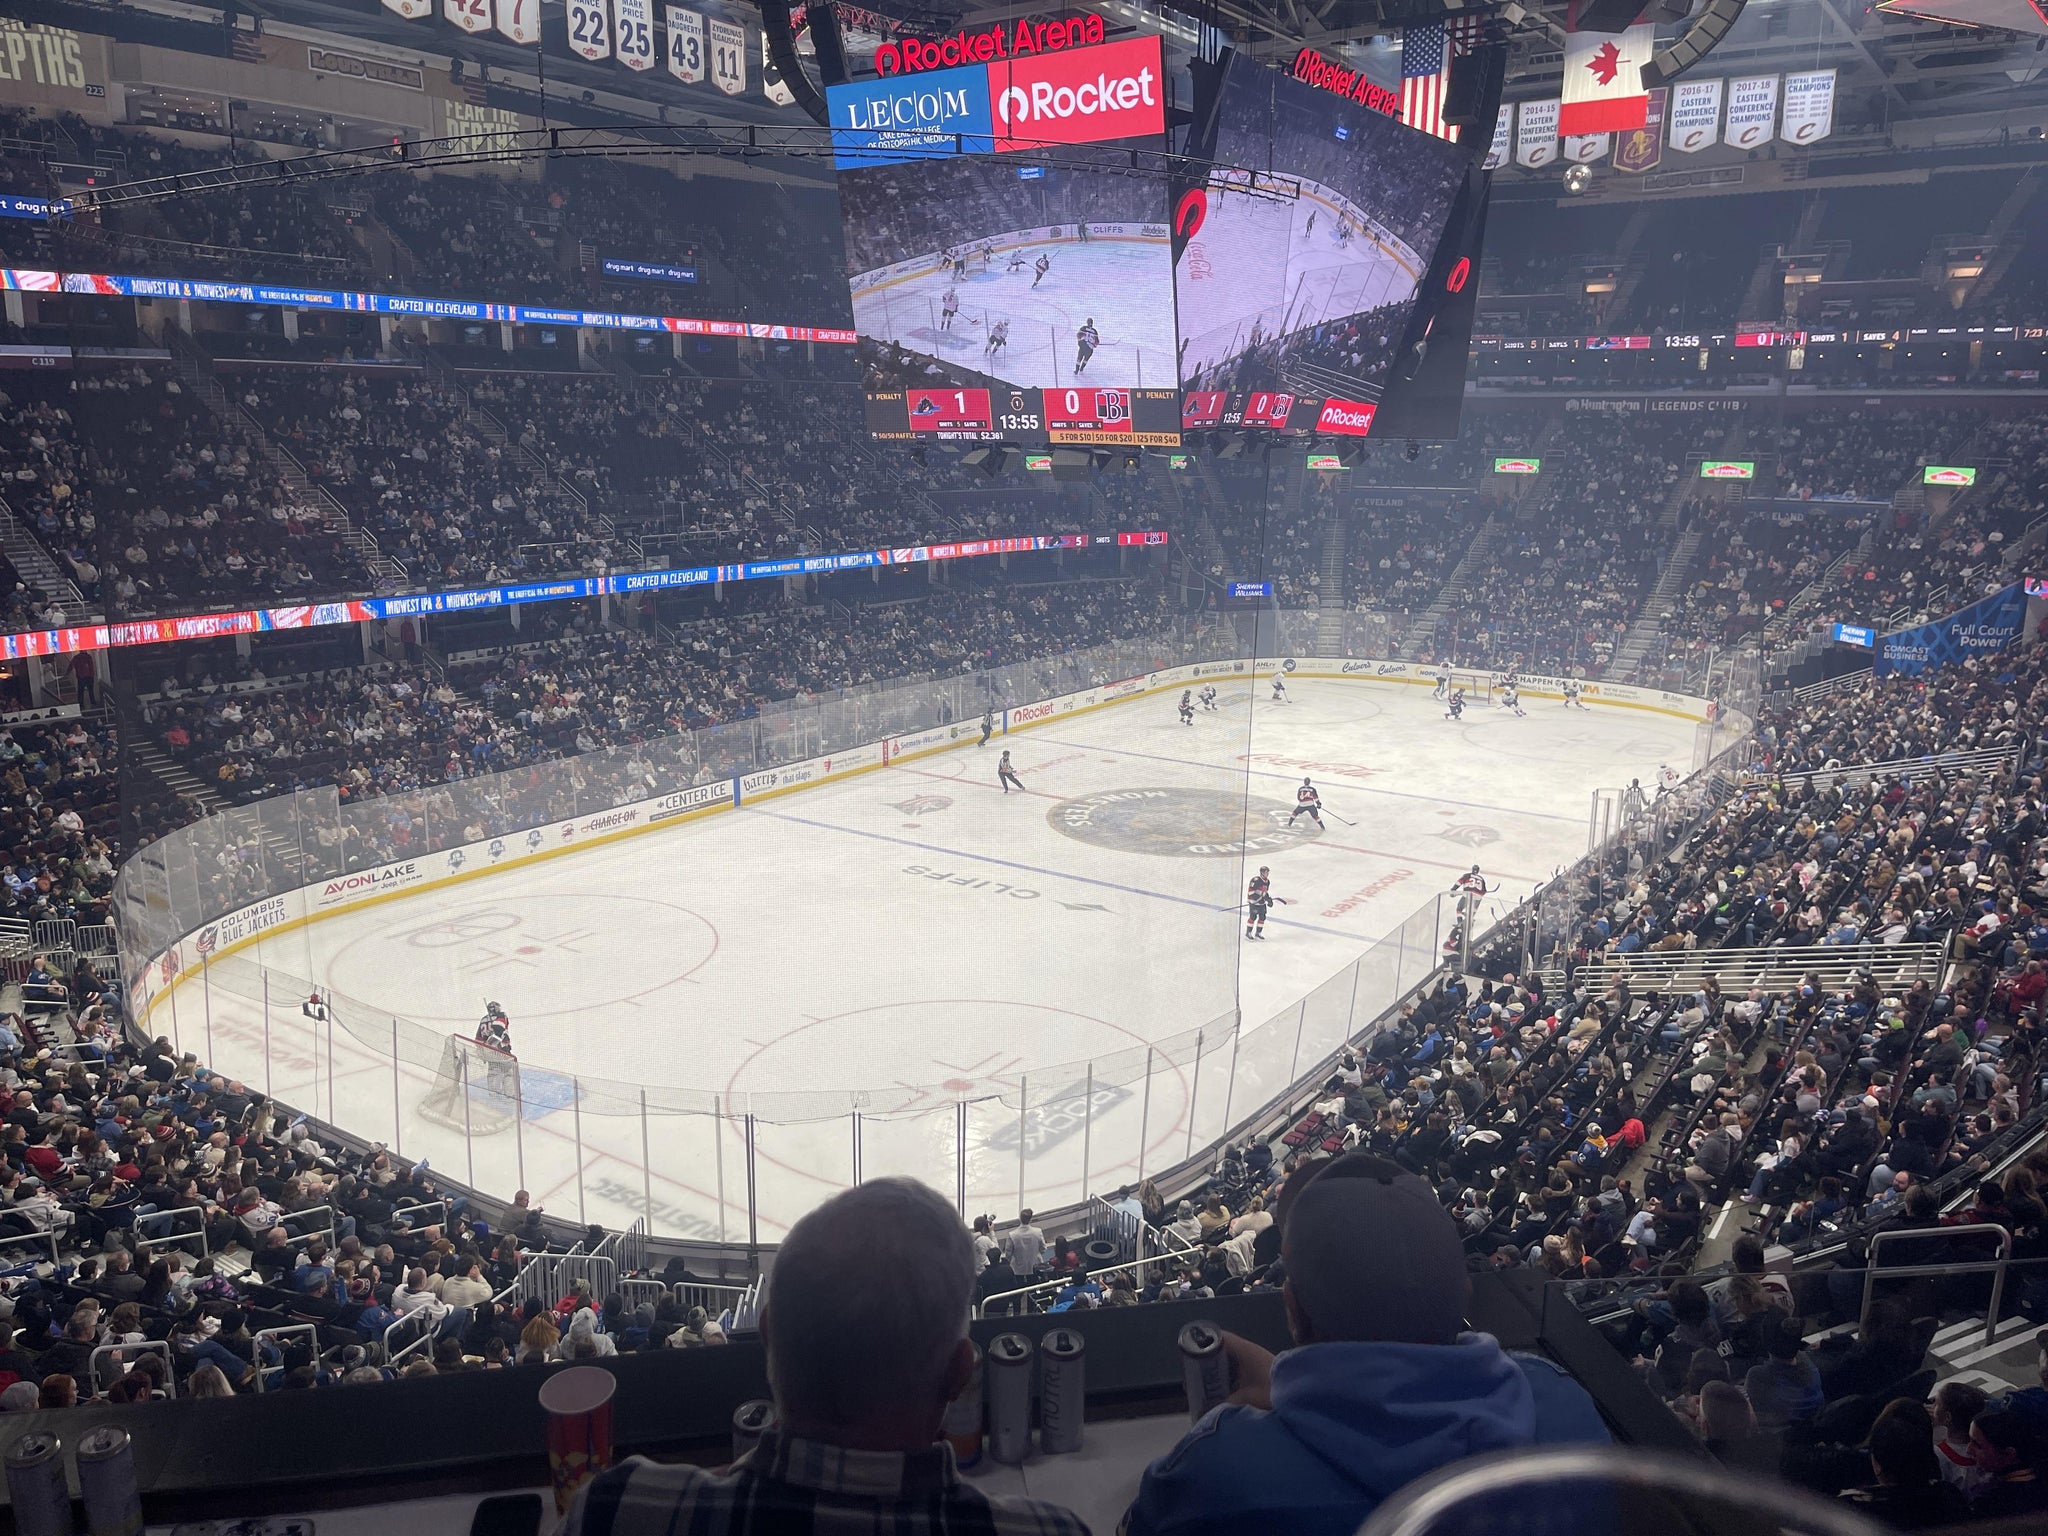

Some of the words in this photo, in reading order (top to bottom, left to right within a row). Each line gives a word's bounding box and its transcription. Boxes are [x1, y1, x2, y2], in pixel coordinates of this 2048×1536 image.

[622, 7, 644, 20] PRICE
[675, 12, 694, 24] BRAD
[572, 6, 605, 47] 22
[712, 23, 743, 39] ZYDRUNAS
[619, 18, 649, 58] 25
[902, 23, 1006, 72] Rocket
[1012, 14, 1104, 55] Arena
[671, 33, 700, 70] 43
[717, 46, 739, 82] 11
[1307, 52, 1356, 100] Rocket
[1353, 75, 1398, 116] Arena
[1736, 80, 1771, 91] 2017-18
[1788, 82, 1831, 93] CHAMPIONS
[86, 85, 105, 97] 223
[1031, 66, 1155, 121] Rocket
[1681, 85, 1714, 96] 2016-17
[1681, 98, 1712, 107] EASTERN
[1737, 93, 1768, 103] EASTERN
[1525, 104, 1556, 115] 2014-15
[1674, 107, 1717, 118] CONFERENCE
[1729, 103, 1774, 113] CONFERENCE
[1525, 116, 1553, 126] EASTERN
[1675, 118, 1714, 128] CHAMPIONS
[1730, 113, 1771, 124] CHAMPIONS
[1520, 124, 1558, 135] CONFERENCE
[1520, 135, 1556, 145] CHAMPIONS
[15, 201, 40, 215] drug
[1093, 225, 1124, 234] CLIFFS
[606, 261, 619, 272] drug
[620, 264, 634, 272] mart
[637, 265, 651, 275] drug
[651, 267, 664, 275] mart
[668, 268, 681, 278] drug
[131, 279, 167, 296] MIDWEST
[168, 281, 181, 296] IPA
[389, 299, 423, 312] CRAFTED
[426, 301, 433, 313] IN
[435, 302, 477, 316] CLEVELAND
[817, 330, 838, 340] CRAFTED
[839, 331, 846, 341] IN
[1665, 335, 1700, 348] 13:55
[1757, 333, 1766, 345] 0
[1810, 334, 1835, 343] SHOTS
[1842, 332, 1847, 342] 1
[1863, 332, 1886, 341] SAVES
[1530, 339, 1537, 349] 5
[1574, 339, 1579, 348] 1
[1623, 337, 1631, 349] 1
[1146, 391, 1174, 399] PENALTY
[954, 391, 966, 414] 1
[1065, 390, 1080, 415] 0
[1102, 390, 1124, 422] B
[1208, 394, 1217, 414] 1
[1256, 394, 1267, 414] 0
[1651, 401, 1705, 411] LEGENDS
[1000, 414, 1039, 430] 13:55
[1222, 413, 1241, 424] 13:55
[1330, 408, 1371, 428] Rocket
[937, 432, 962, 440] TONIGHT'S
[962, 432, 978, 440] TOTAL
[1059, 433, 1064, 441] 5
[1065, 433, 1078, 441] FOR
[1079, 433, 1091, 441] $10
[1095, 434, 1104, 442] 50
[1105, 434, 1118, 442] FOR
[1119, 434, 1132, 442] $20
[1137, 434, 1149, 443] 125
[1150, 435, 1163, 443] FOR
[1164, 435, 1178, 444] $40
[1076, 536, 1082, 546] 5
[1096, 536, 1110, 544] SHOTS
[1127, 535, 1131, 545] 1
[627, 573, 658, 589] CRAFTED
[660, 573, 668, 585] IN
[669, 570, 709, 584] CLEVELAND
[1235, 582, 1264, 590] SHERWIN
[386, 598, 420, 616] MIDWEST
[420, 597, 432, 612] IPA
[435, 596, 443, 609] &
[446, 592, 478, 608] MIDWEST
[143, 622, 159, 640] IPA
[176, 616, 220, 638] MIDWEST
[1841, 625, 1867, 637] SHERWIN
[1951, 624, 1975, 636] Full
[1978, 624, 2014, 637] Court
[1960, 636, 2003, 648] Power
[1884, 644, 1930, 655] COMCAST
[1883, 652, 1928, 662] BUSINESS
[1342, 660, 1372, 674] Culver's
[1377, 664, 1407, 676] Culver's
[1518, 675, 1554, 686] HAPPEN
[1022, 702, 1054, 722] Rocket
[665, 787, 708, 809] CENTER
[710, 783, 726, 798] ICE
[324, 863, 416, 895] AVONLAKE
[381, 880, 398, 889] Jeep
[901, 865, 1041, 900] CLIFFS
[1320, 892, 1362, 919] Arena
[221, 898, 284, 929] COLUMBUS
[223, 925, 244, 944] BLUE
[247, 908, 286, 934] JACKETS
